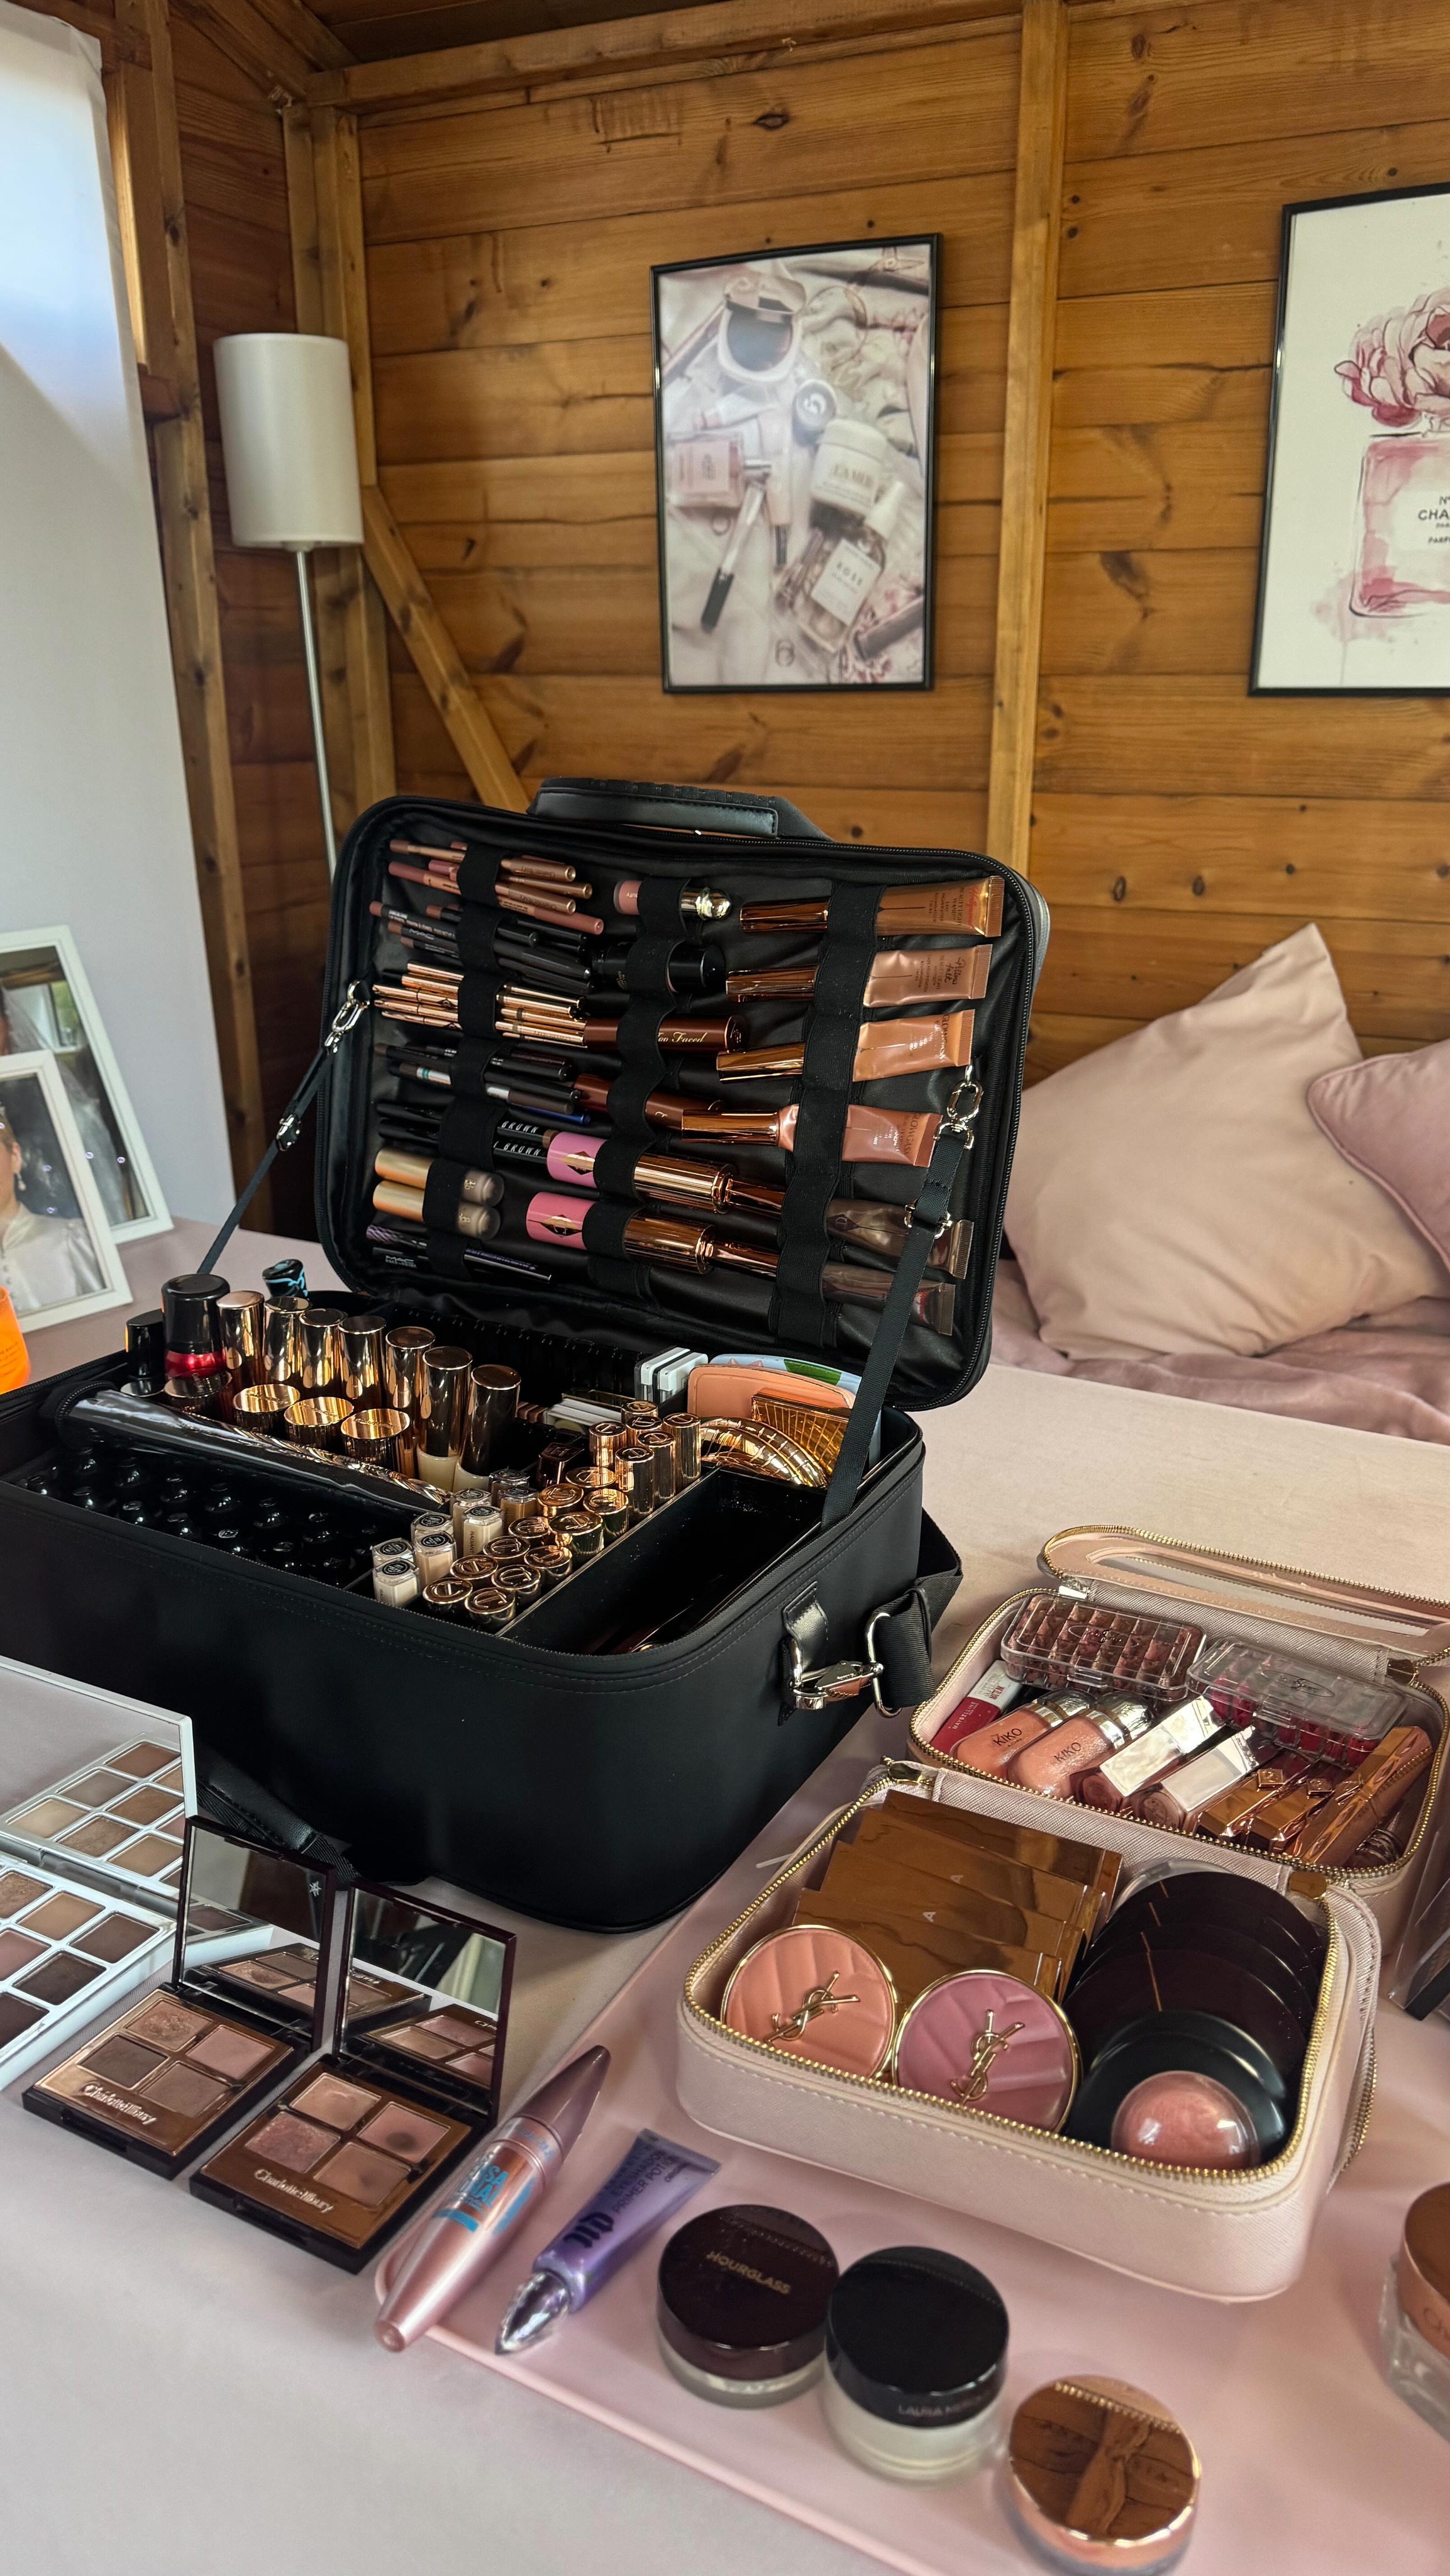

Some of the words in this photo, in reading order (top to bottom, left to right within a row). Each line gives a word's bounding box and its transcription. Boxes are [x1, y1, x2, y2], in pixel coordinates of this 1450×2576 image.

[672, 1031, 708, 1043] Faced
[501, 1121, 540, 1134] BROWN
[503, 1142, 541, 1157] BROWN
[952, 1701, 977, 1730] MAYBELLINE
[993, 1728, 1023, 1746] KIKO
[1053, 1741, 1082, 1763] KIKO
[706, 2250, 791, 2295] HOURGLASS
